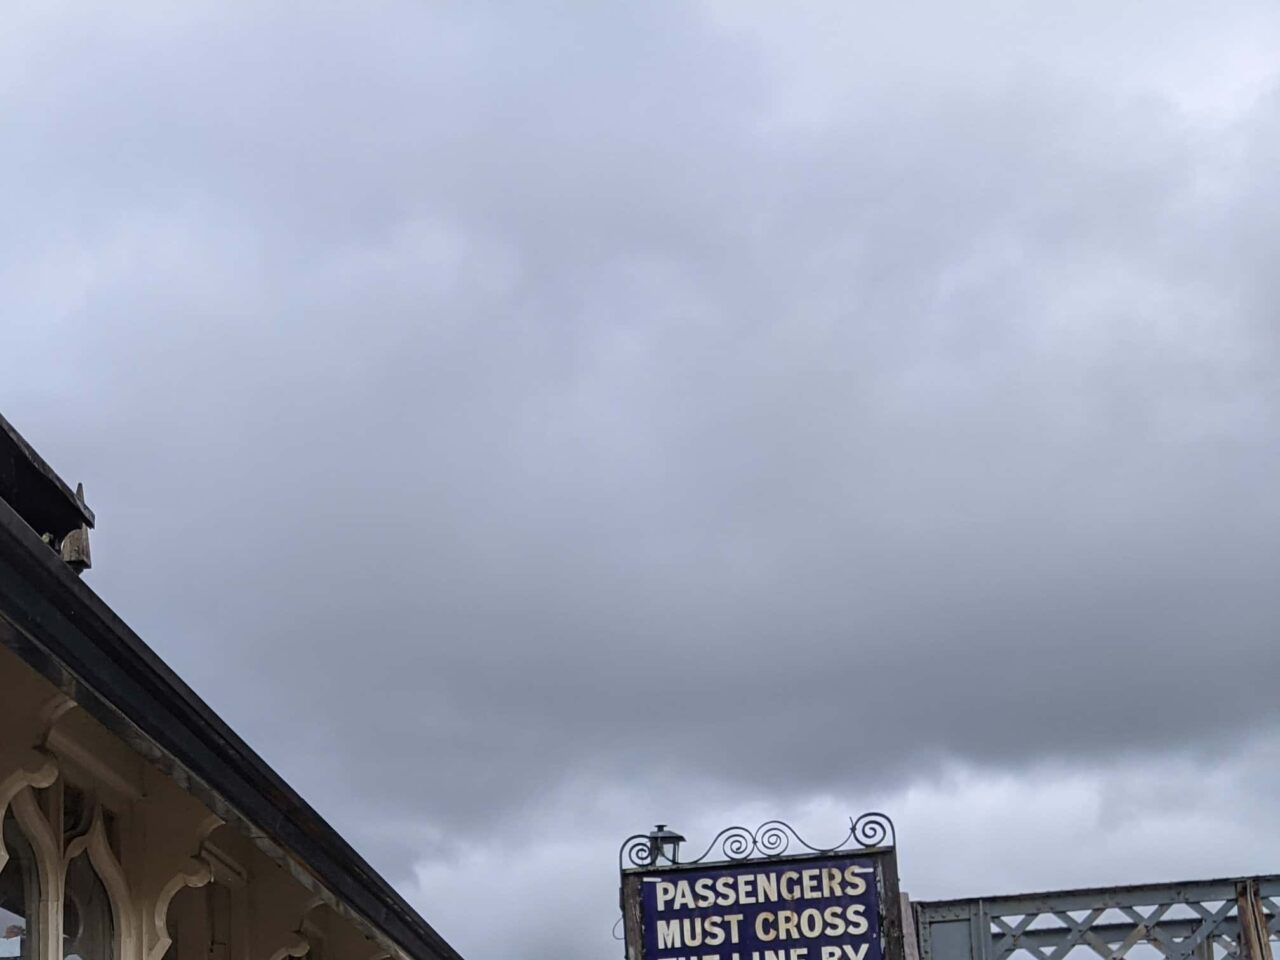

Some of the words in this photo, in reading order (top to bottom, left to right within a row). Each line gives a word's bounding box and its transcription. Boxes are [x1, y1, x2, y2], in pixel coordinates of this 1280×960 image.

[656, 865, 867, 911] PASSENGERS
[657, 914, 744, 950] MUST
[755, 904, 869, 942] CROSS
